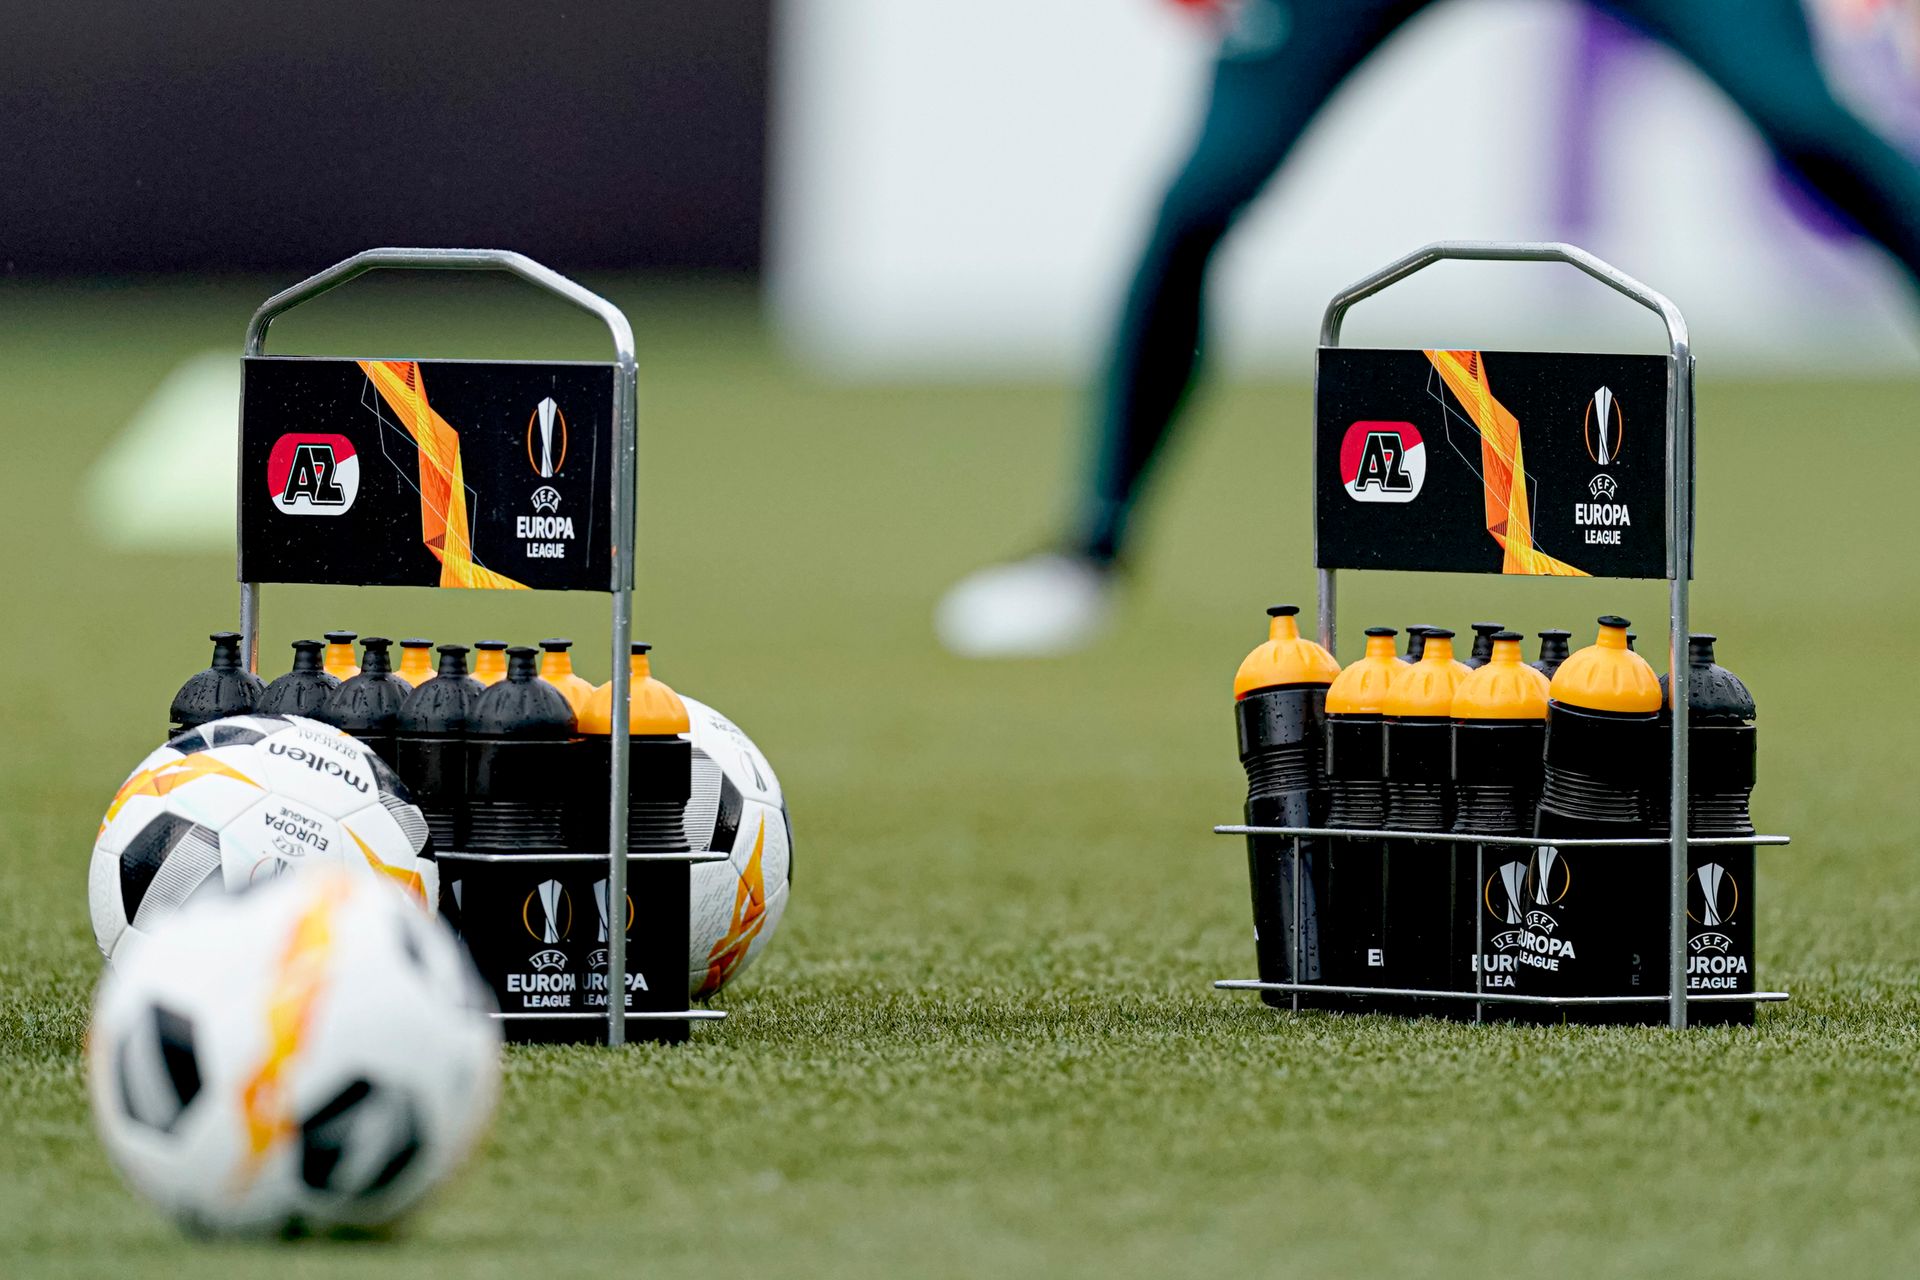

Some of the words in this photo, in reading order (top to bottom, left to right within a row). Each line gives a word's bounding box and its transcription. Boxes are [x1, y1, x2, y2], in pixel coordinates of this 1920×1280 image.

[1354, 431, 1413, 492] AZ
[283, 444, 346, 506] AZ
[1589, 477, 1616, 498] UEFA
[532, 488, 560, 511] UEFA
[1575, 503, 1631, 526] EUROPA
[516, 516, 575, 540] EUROPA
[1584, 530, 1621, 545] LEAGUE
[526, 543, 565, 559] LEAGUE
[268, 742, 369, 794] molten
[280, 806, 323, 832] LEAGUE
[264, 811, 329, 852] EUROPA
[1526, 913, 1555, 933] UEFA
[1690, 935, 1730, 951] UEFA
[530, 953, 567, 969] UEFA
[1519, 950, 1560, 972] LEAGUE
[1686, 956, 1747, 974] UROPA
[506, 973, 576, 992] EUROPA
[523, 995, 571, 1008] LEAGUE
